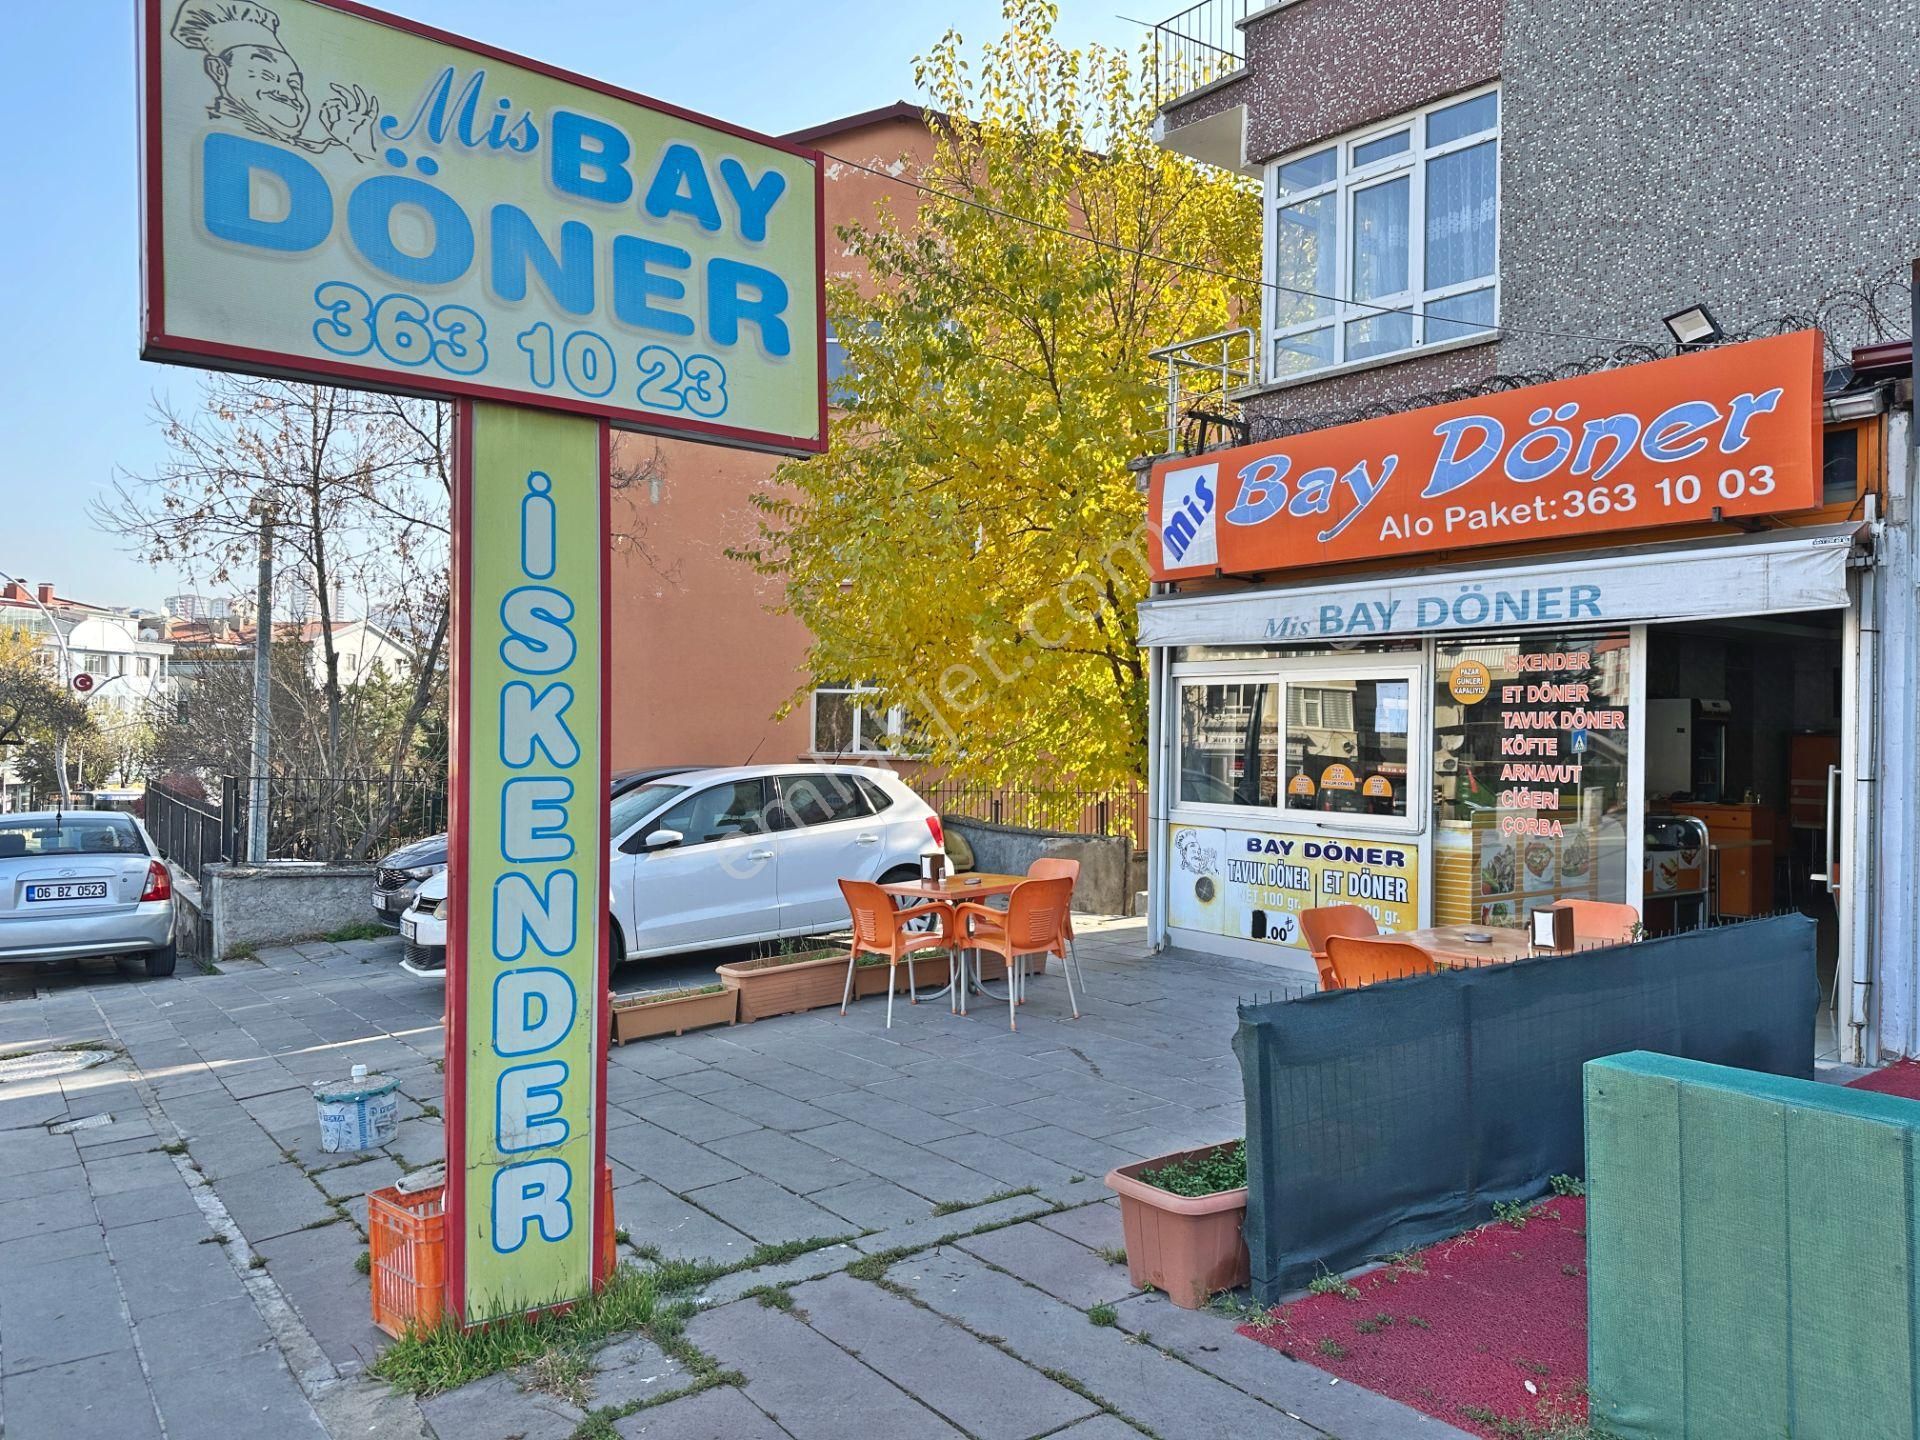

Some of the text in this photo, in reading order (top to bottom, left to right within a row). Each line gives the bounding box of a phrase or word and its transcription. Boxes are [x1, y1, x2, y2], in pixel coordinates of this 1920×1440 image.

[380, 66, 785, 242] Mis BAY
[203, 131, 791, 358] DÖNER
[312, 280, 729, 418] 363 10 23
[1225, 387, 1784, 543] Bay Döner
[1163, 474, 1215, 563] mis
[1379, 515, 1434, 542] Alo
[1654, 473, 1701, 506] 10
[1717, 464, 1776, 500] 03
[1263, 584, 1603, 639] Mis BAY DÖNER
[1502, 682, 1589, 703] ET DÖNER
[1501, 707, 1626, 730] TAVUK DÖNER
[1501, 734, 1558, 756] KÖFTE
[1500, 763, 1582, 783] ARNAVUT
[1501, 786, 1559, 810] CİĞERİ
[1501, 817, 1564, 838] ÇORBA
[491, 470, 581, 1254] İSKENDER
[1247, 837, 1405, 867] BAY DÖNER
[1228, 858, 1311, 891] TAVUK DÖNER
[1322, 868, 1409, 904] ET DÖNER
[36, 885, 105, 898] 06 BZ 0523
[1263, 891, 1284, 907] 100
